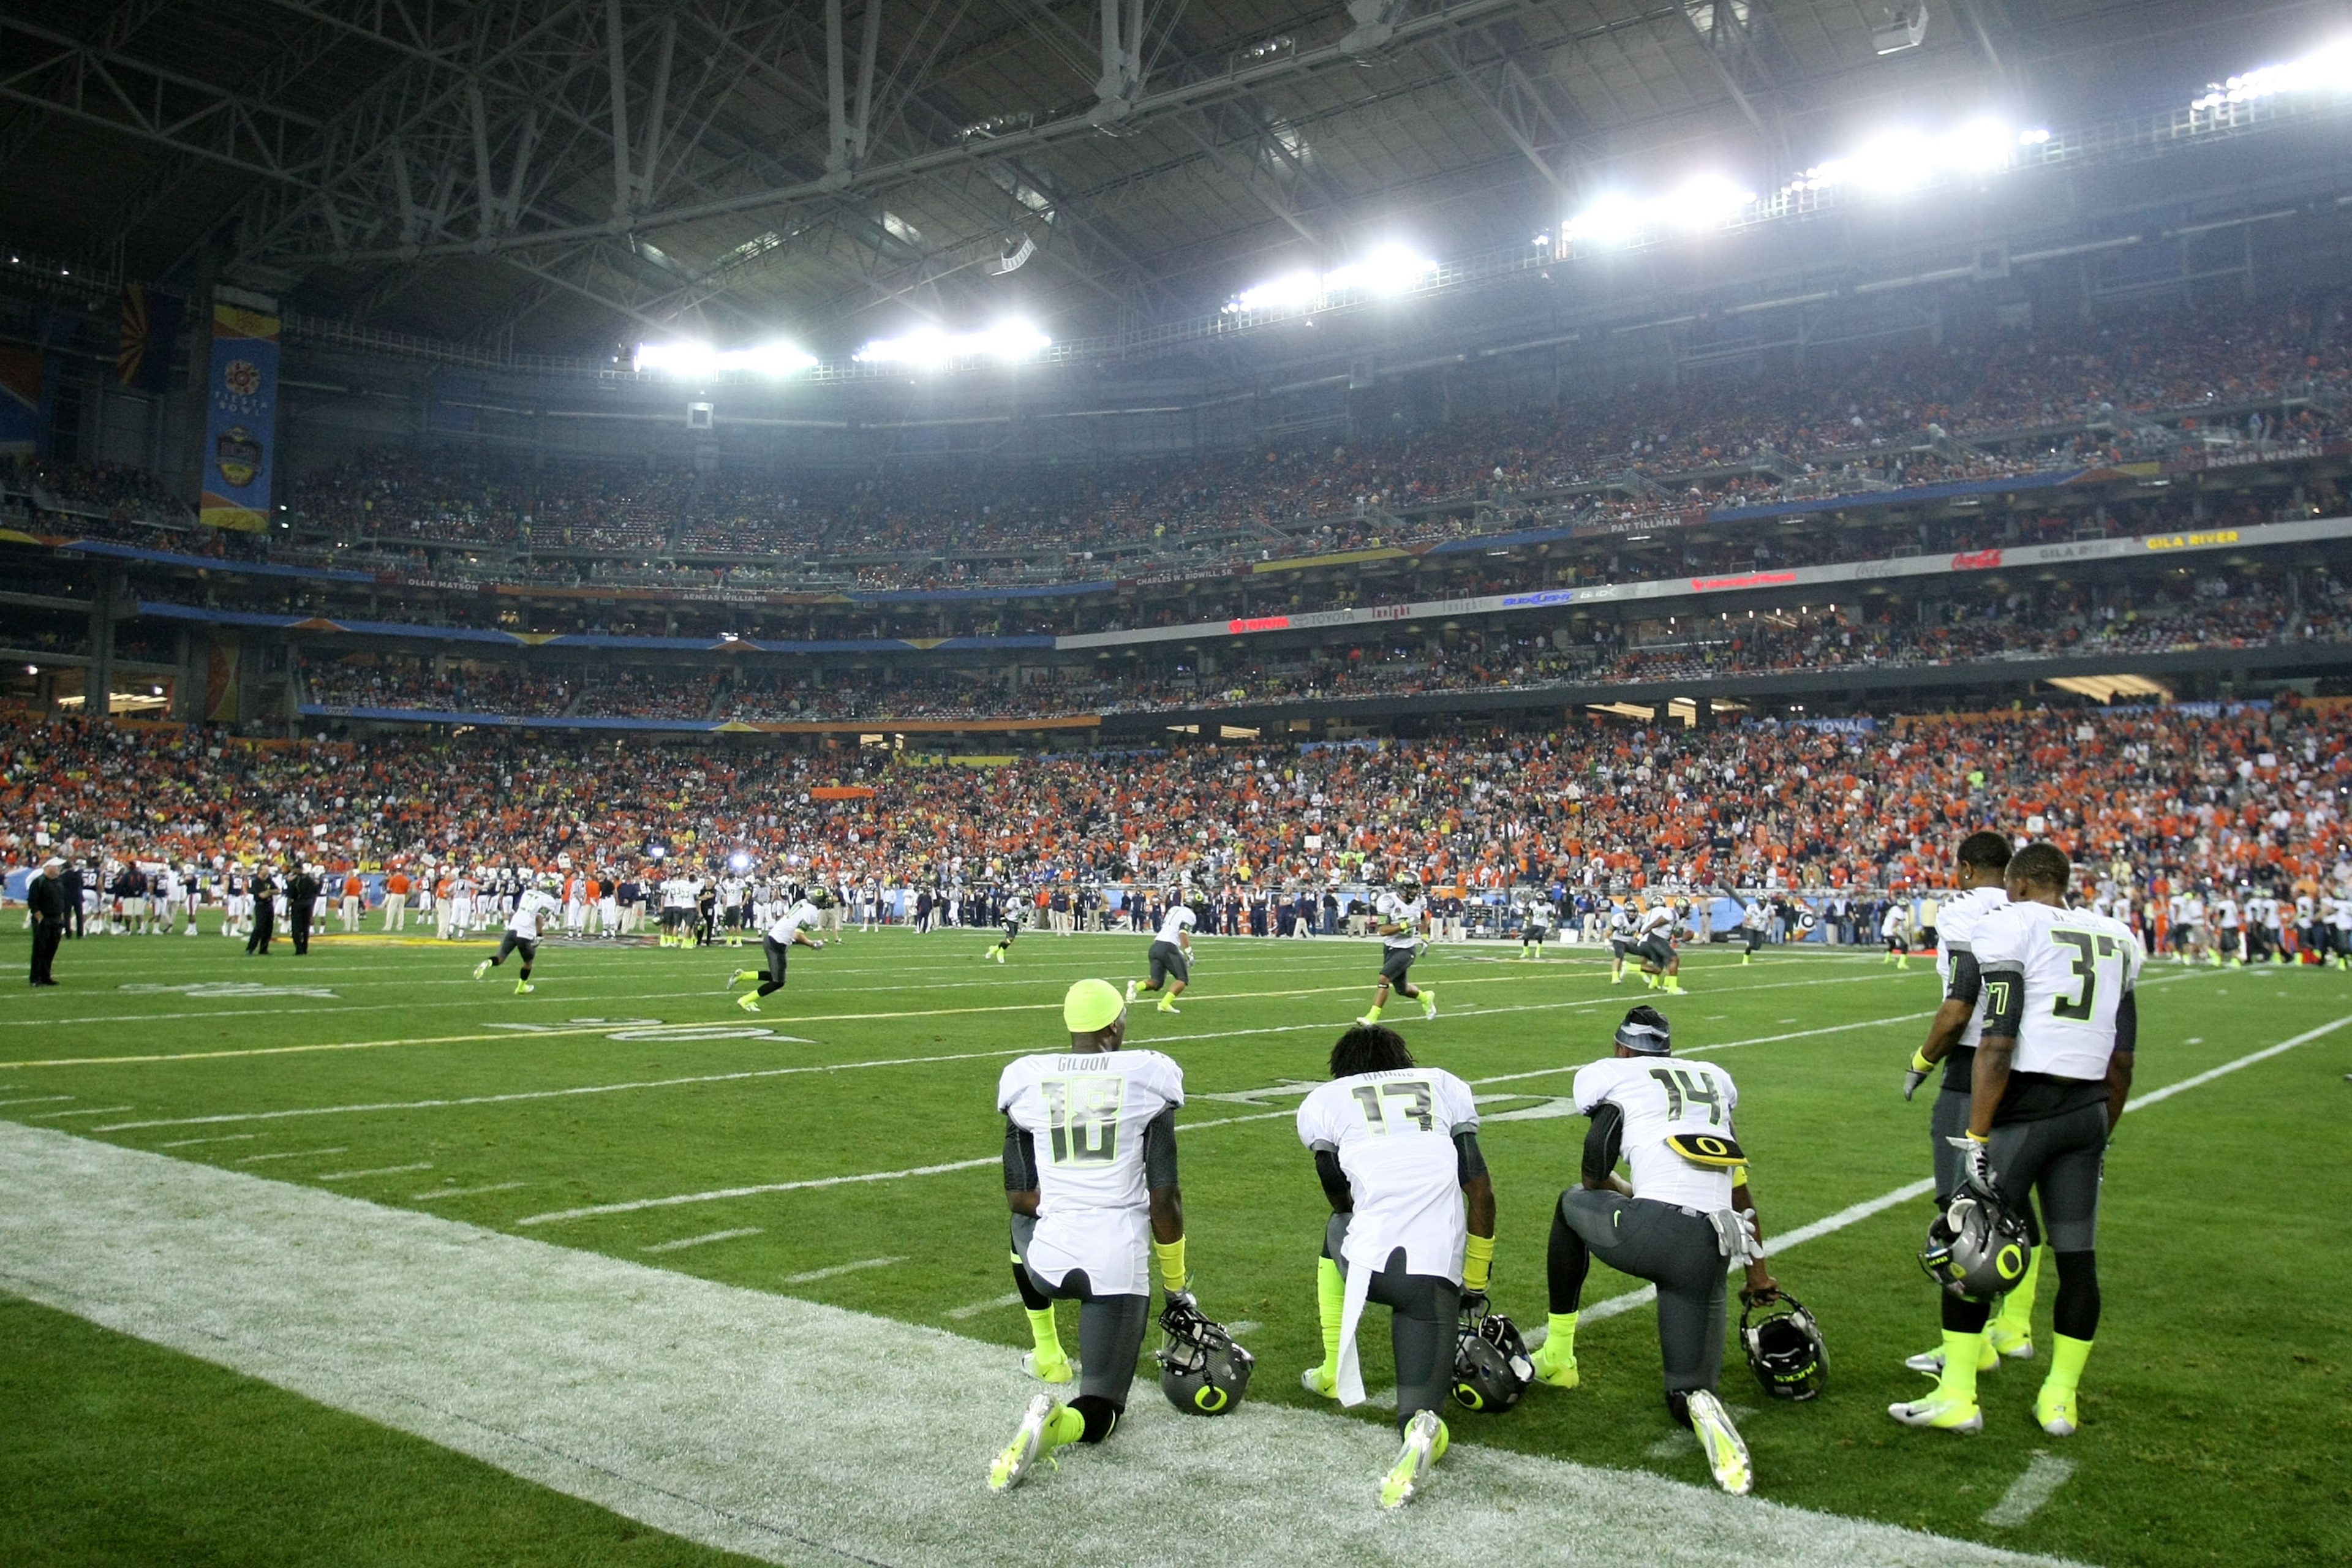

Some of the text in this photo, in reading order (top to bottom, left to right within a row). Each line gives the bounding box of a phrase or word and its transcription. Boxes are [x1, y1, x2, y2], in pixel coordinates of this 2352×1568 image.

[219, 401, 260, 417] BOWL
[1611, 524, 1630, 533] PAT
[1634, 518, 1681, 530] TILLMAN
[2146, 530, 2239, 550] GILA RIVER
[408, 578, 479, 591] OLLIE MATSON
[1136, 574, 1172, 586] CHARLES
[722, 594, 767, 603] WILLIAMS
[1310, 612, 1355, 624] TOYOTA
[2049, 928, 2135, 1023] 37
[1057, 1057, 1110, 1072] GILDON
[1648, 1066, 1723, 1126] 14
[1041, 1074, 1125, 1166] 18
